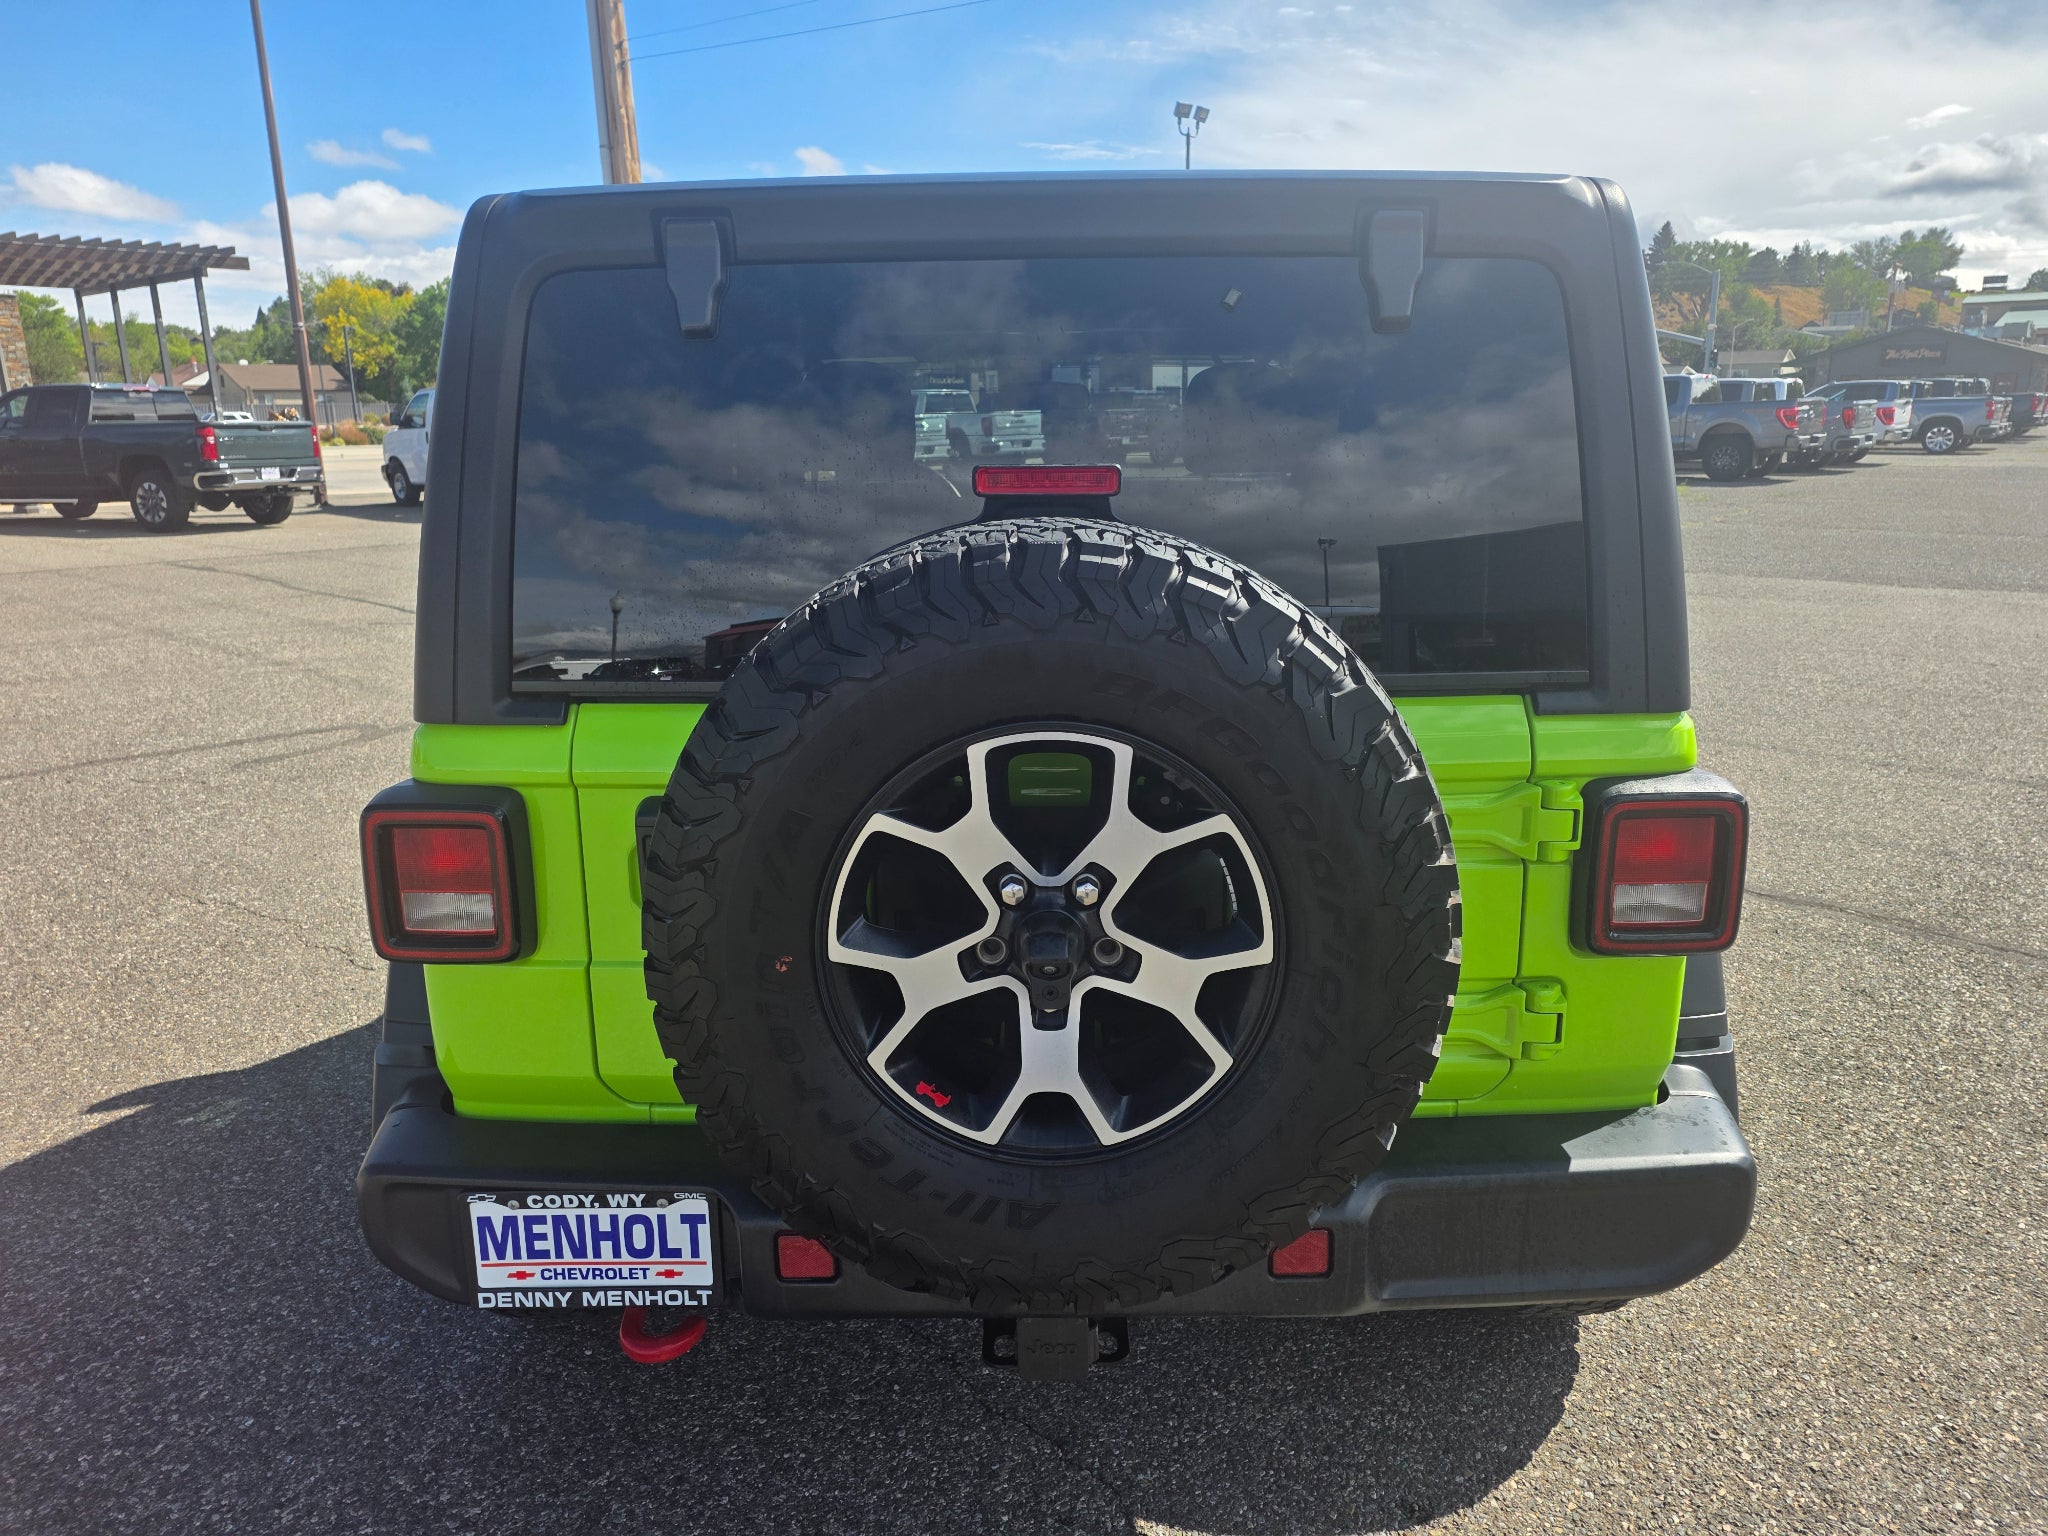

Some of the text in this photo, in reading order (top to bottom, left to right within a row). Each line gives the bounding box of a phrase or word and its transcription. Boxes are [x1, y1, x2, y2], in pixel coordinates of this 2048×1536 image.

[526, 1193, 646, 1209] CODY, WY
[673, 1192, 707, 1200] GMC
[476, 1213, 707, 1261] MENHOLT
[540, 1267, 650, 1281] CHEVROLET
[477, 1289, 713, 1309] DENNY MENHOLT
[1026, 1338, 1080, 1356] Jeep
